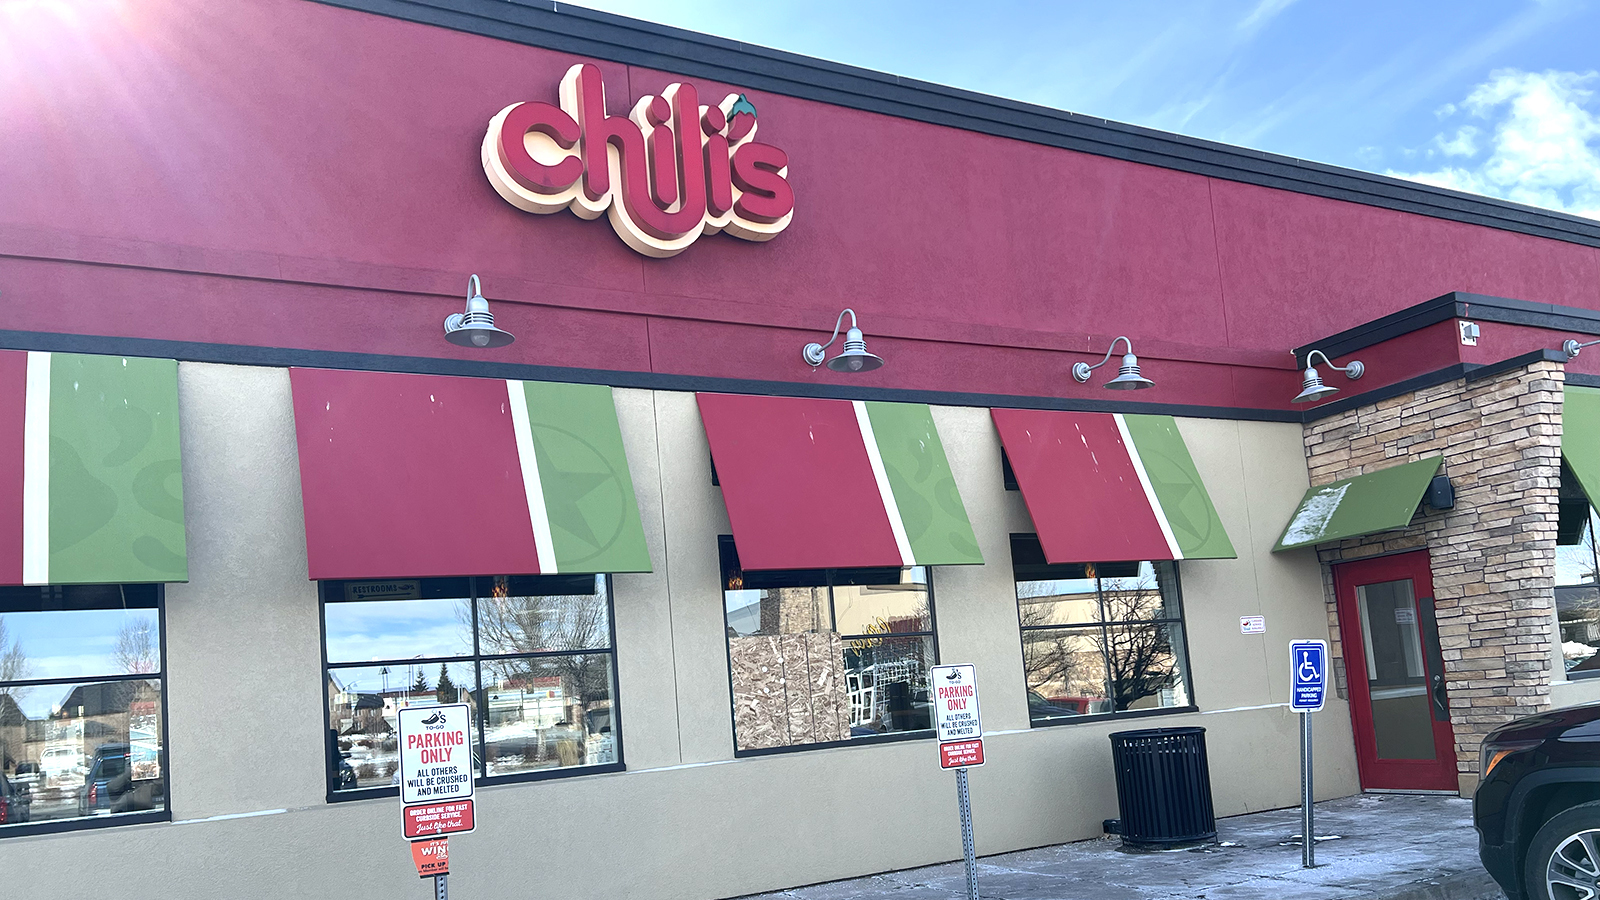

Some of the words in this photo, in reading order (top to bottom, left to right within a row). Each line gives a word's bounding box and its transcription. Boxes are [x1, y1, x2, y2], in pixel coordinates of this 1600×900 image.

[482, 63, 796, 258] chili's
[352, 584, 397, 594] RESTROOMS
[938, 685, 973, 699] PARKING
[947, 698, 967, 711] ONLY
[955, 712, 971, 720] OTHERS
[958, 719, 977, 728] CRUSHED
[957, 727, 973, 735] MELTED
[408, 730, 464, 749] PARKING
[421, 747, 452, 764] ONLY
[417, 768, 429, 778] ALL
[431, 765, 458, 777] OTHERS
[407, 779, 424, 788] WILL
[426, 777, 435, 787] BE
[436, 773, 468, 785] CRUSHED
[417, 787, 431, 797] AND
[433, 784, 460, 795] MELTED
[416, 822, 433, 834] Just
[434, 820, 446, 831] like
